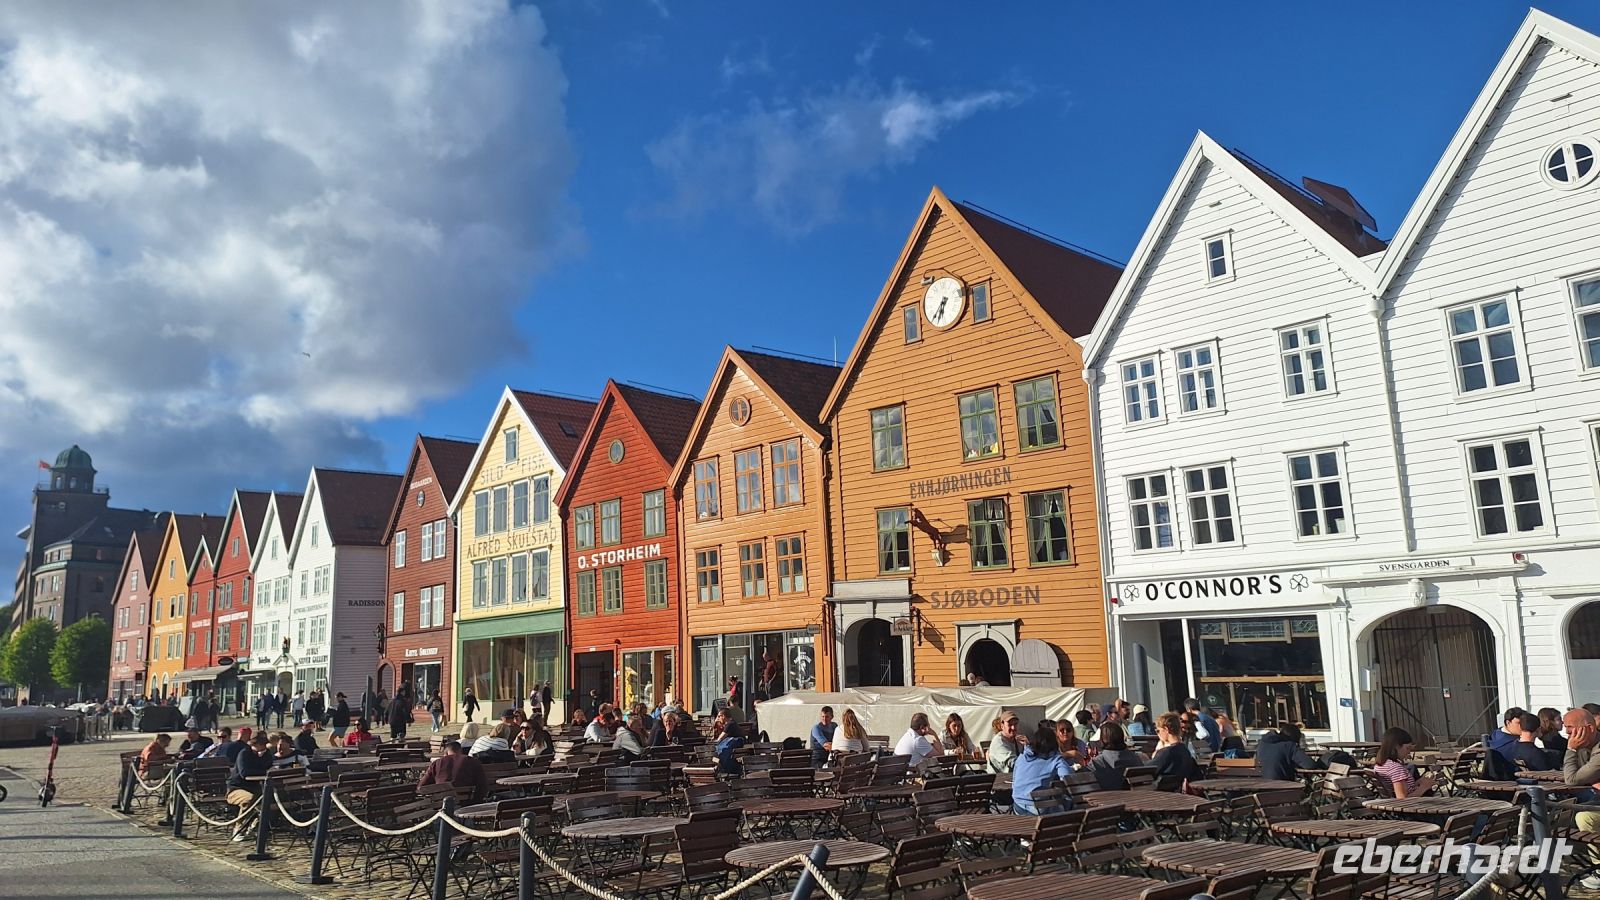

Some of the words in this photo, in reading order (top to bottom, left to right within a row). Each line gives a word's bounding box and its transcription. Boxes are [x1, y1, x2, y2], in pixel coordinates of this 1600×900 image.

[480, 465, 503, 485] SILD
[909, 465, 1012, 500] ENHJØRNINGEN
[466, 538, 501, 558] ALFRED
[507, 528, 556, 551] SKULSTAD
[578, 556, 589, 569] O.
[592, 544, 661, 567] STORHEIM
[1378, 559, 1450, 572] SVENSGARDEN
[931, 585, 1041, 610] SJØBODEN
[1145, 574, 1283, 601] O'CONNOR'S
